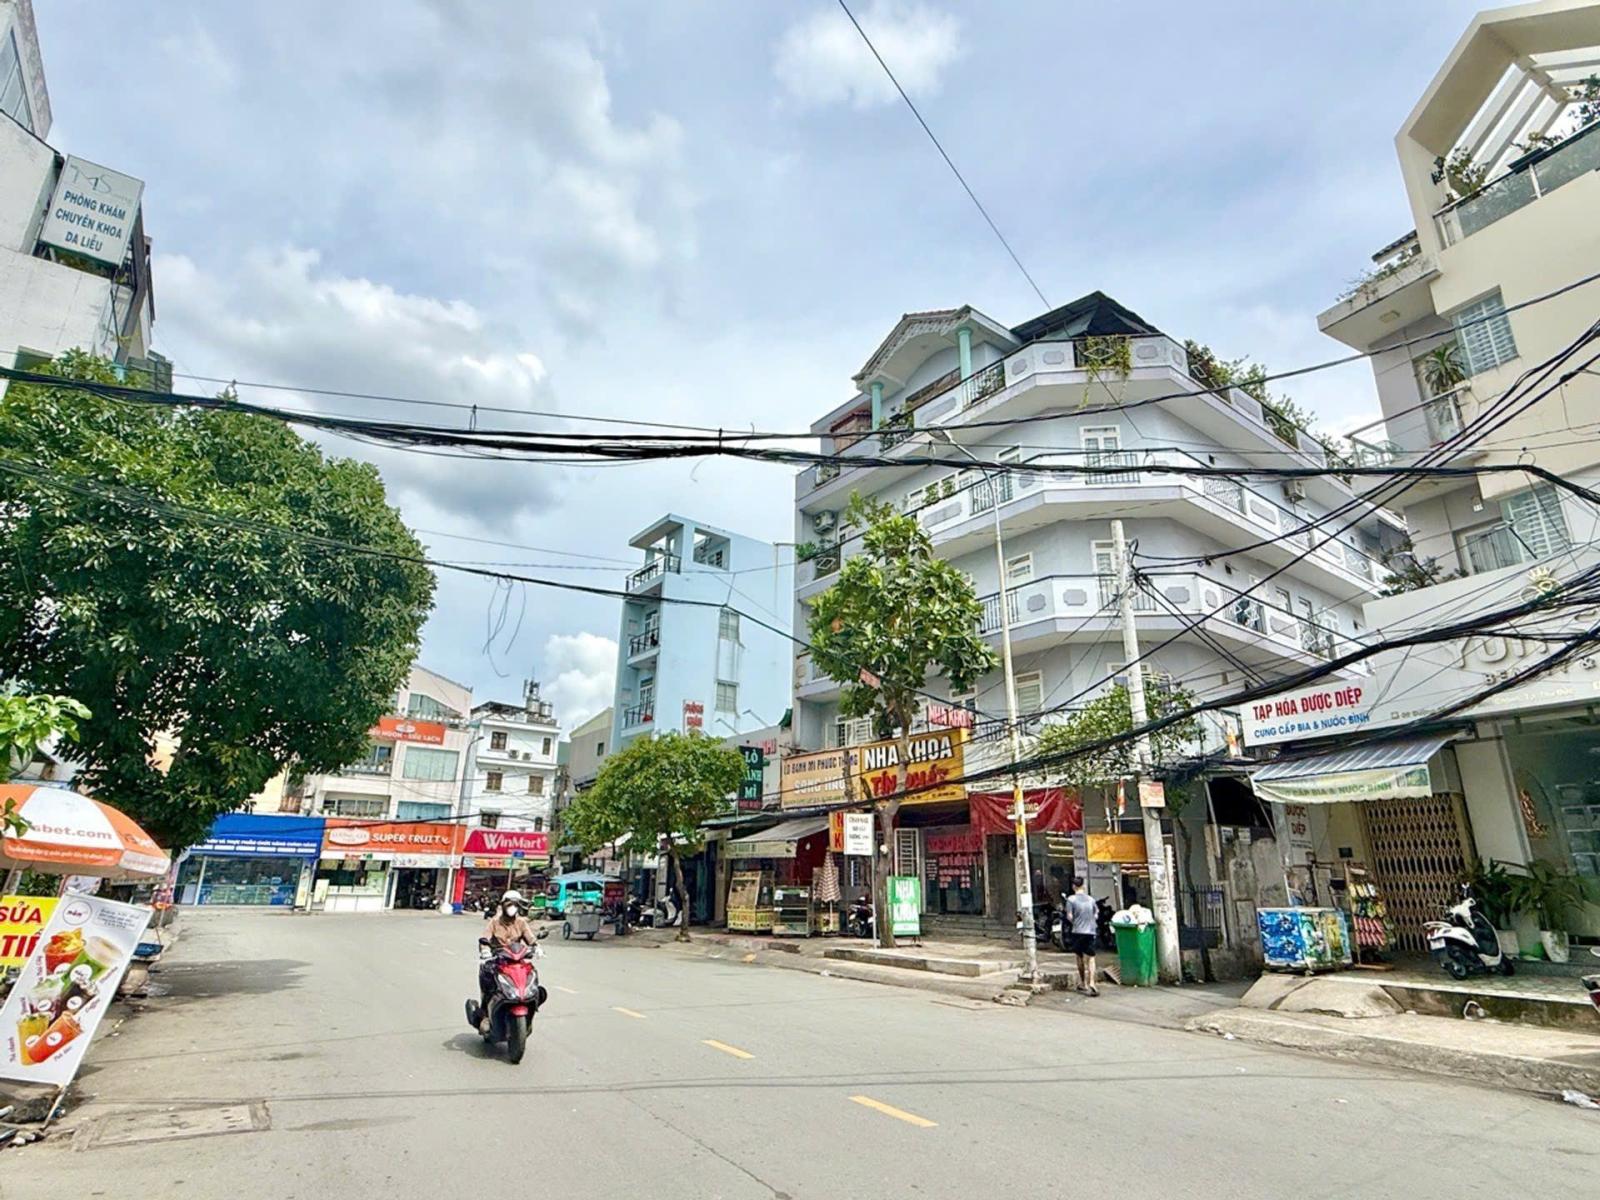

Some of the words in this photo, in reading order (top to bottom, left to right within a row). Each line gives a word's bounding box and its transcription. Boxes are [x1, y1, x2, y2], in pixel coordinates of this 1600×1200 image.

[63, 190, 97, 211] PHÒNG
[99, 202, 127, 220] KHÁM
[55, 208, 95, 231] CHUYÊN
[95, 220, 123, 239] KHOA
[64, 231, 79, 244] DA
[1252, 704, 1273, 723] TẠP
[1275, 698, 1298, 717] HÓA
[1301, 693, 1333, 713] ĐƯỢC
[1334, 686, 1362, 709] DIỆP
[1254, 727, 1277, 738] CUNG
[1278, 721, 1296, 735] CẤP
[1297, 721, 1311, 732] BIA
[1313, 721, 1319, 730] &
[864, 744, 899, 770] NHA
[371, 833, 406, 844] SUPER
